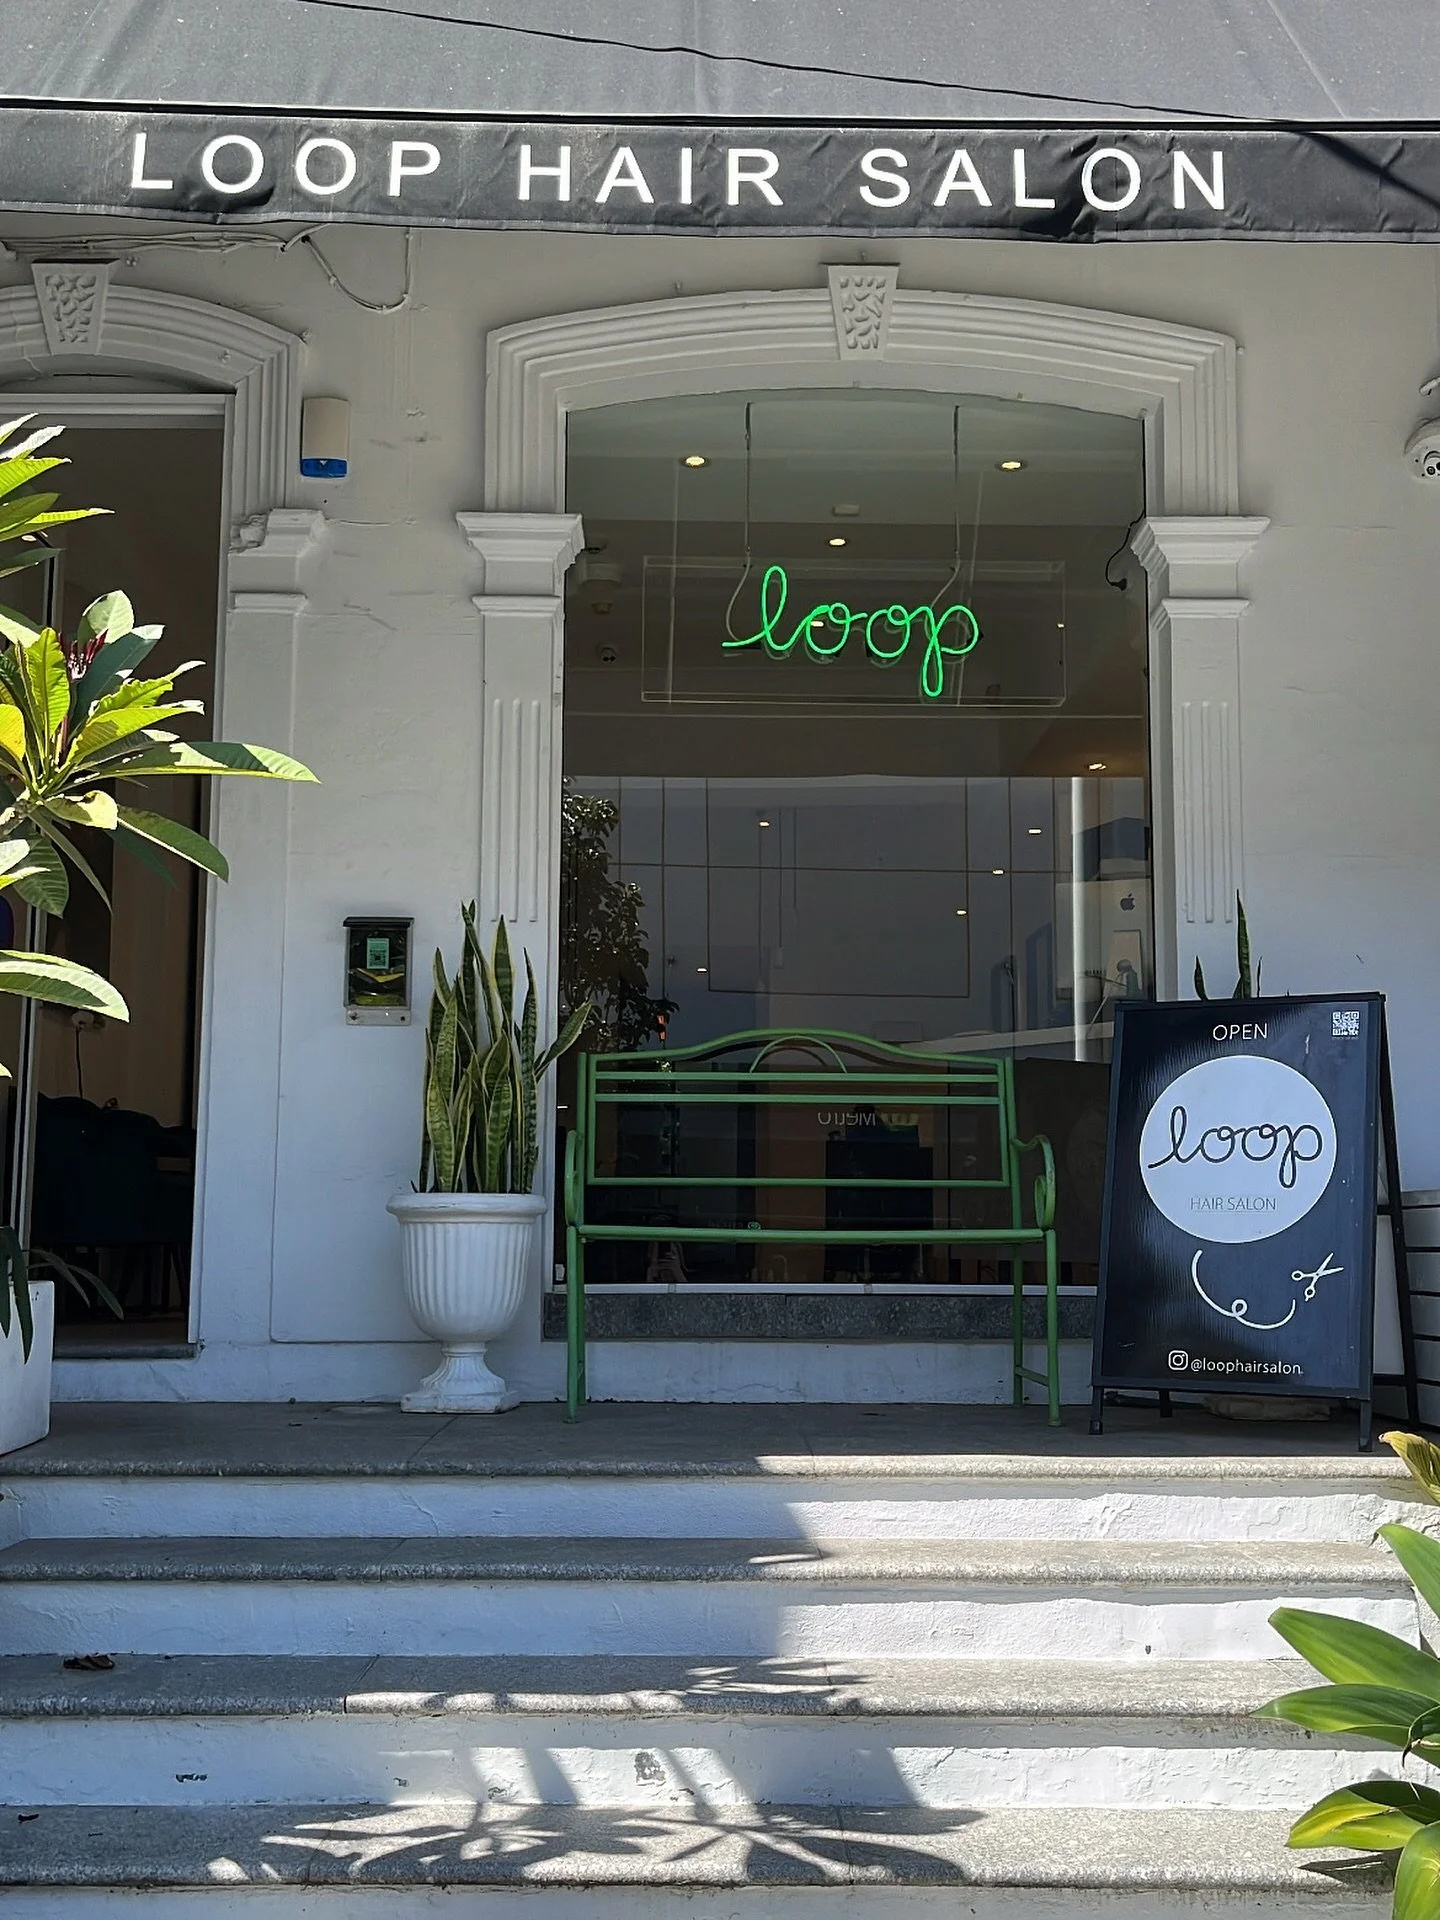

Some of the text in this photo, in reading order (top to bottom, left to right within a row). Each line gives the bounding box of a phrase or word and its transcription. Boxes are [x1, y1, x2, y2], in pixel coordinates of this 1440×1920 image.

[131, 133, 1225, 211] LOOP HAIR SALON
[721, 565, 980, 697] loop
[1212, 1022, 1268, 1041] OPEN
[1147, 1105, 1323, 1189] loop
[1190, 1197, 1276, 1211] HAIR SALON
